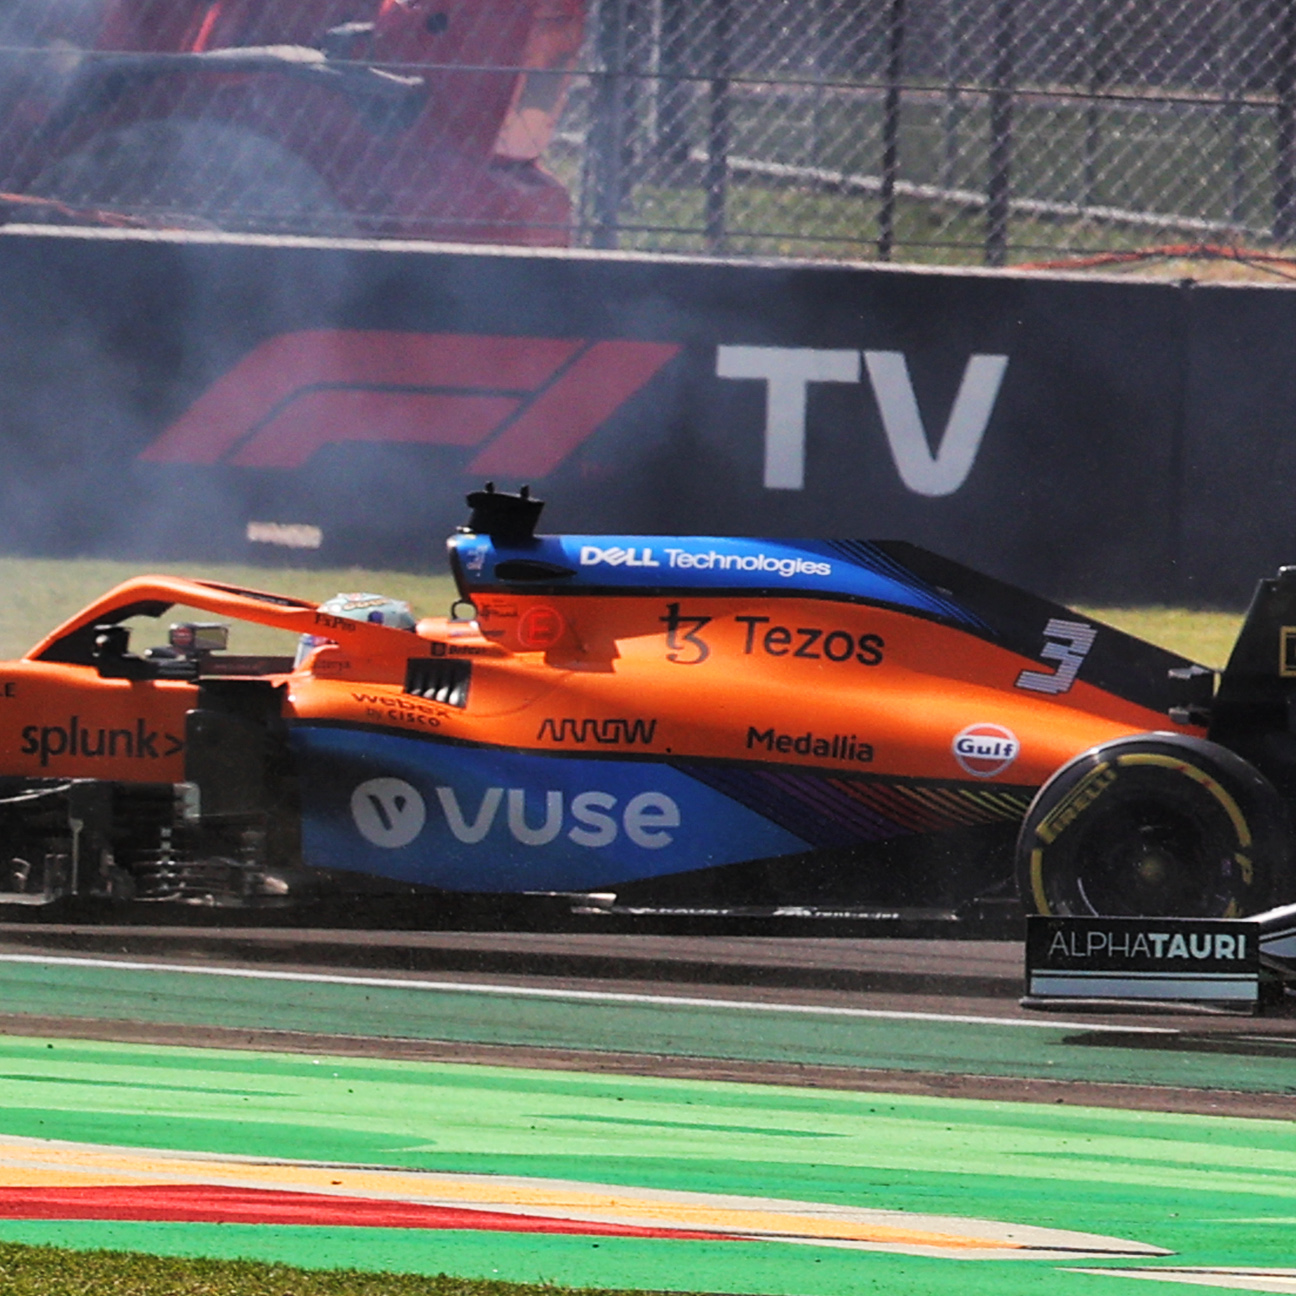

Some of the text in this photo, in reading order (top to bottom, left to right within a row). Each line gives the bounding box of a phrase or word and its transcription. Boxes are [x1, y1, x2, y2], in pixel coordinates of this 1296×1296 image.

[715, 344, 1009, 498] TV
[579, 545, 832, 577] DELL Technologies
[734, 615, 886, 666] Tezos
[1014, 617, 1098, 694] 3
[351, 692, 450, 719] webex
[746, 726, 875, 762] Medallia
[956, 737, 1013, 758] Gulf
[1048, 930, 1246, 960] ALPHATAURI
